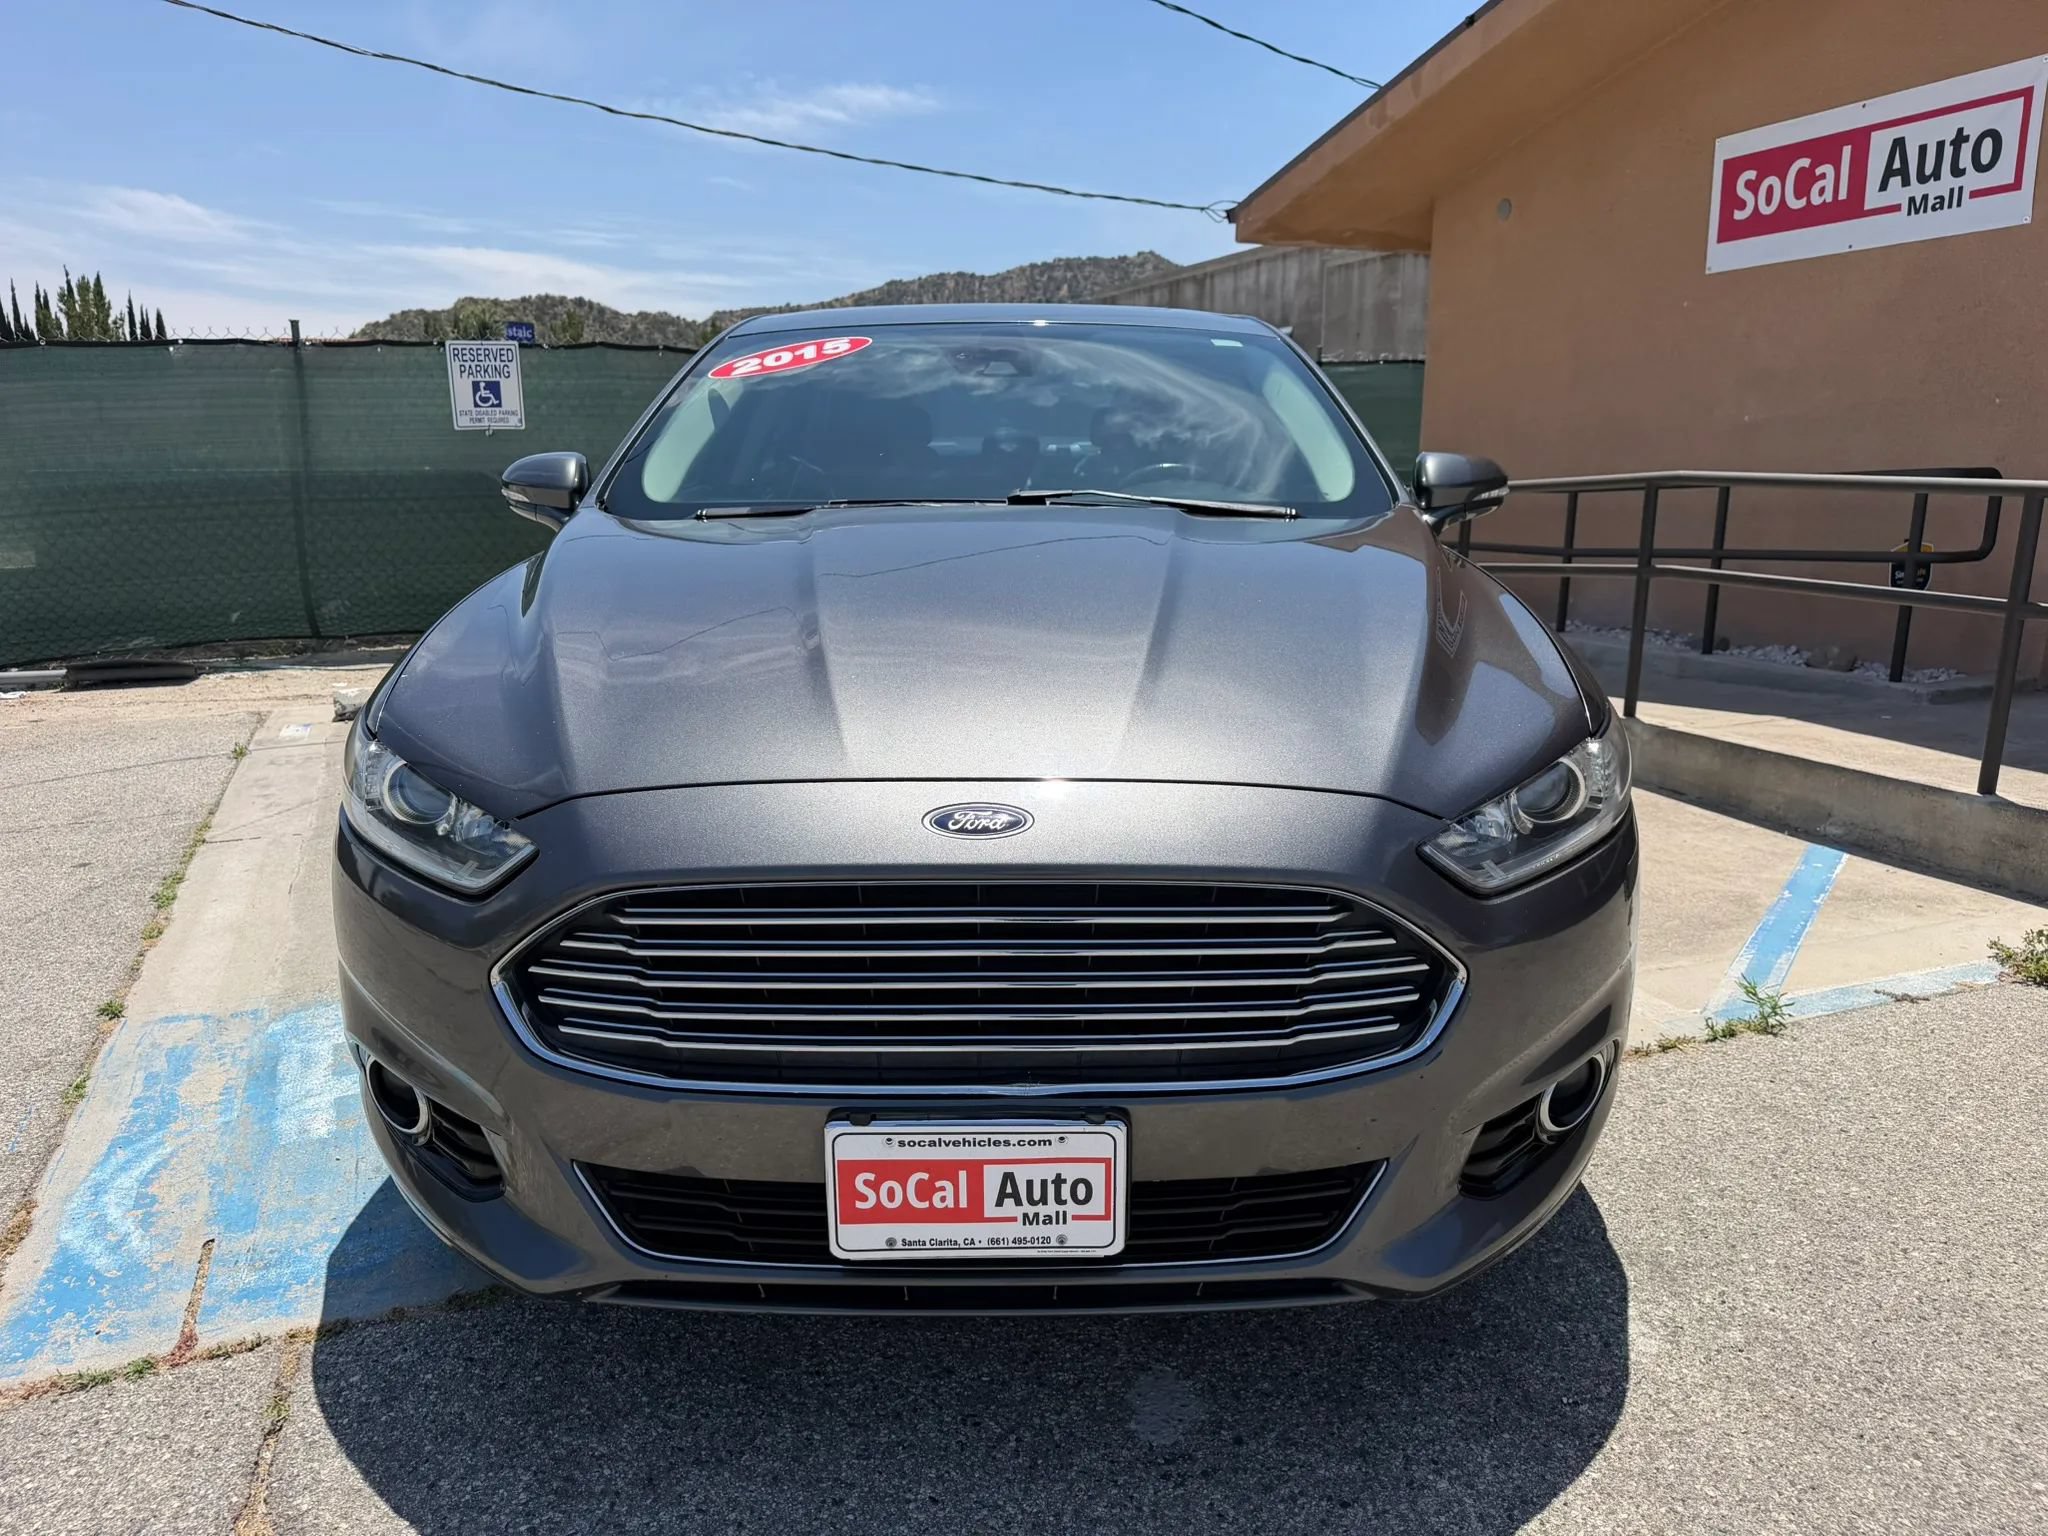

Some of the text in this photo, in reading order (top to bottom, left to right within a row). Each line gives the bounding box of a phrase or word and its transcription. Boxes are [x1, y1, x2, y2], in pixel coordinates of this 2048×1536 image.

[1732, 126, 2003, 221] SoCal Auto
[1906, 185, 1964, 217] Mall
[452, 347, 514, 362] RESERVED
[730, 338, 851, 376] 2015
[459, 364, 511, 379] PARKING
[948, 810, 1010, 830] Ford
[897, 1137, 1053, 1148] socalvehicles.com
[854, 1169, 1094, 1210] SoCal Auto
[1021, 1210, 1068, 1226] Mall
[901, 1235, 1051, 1248] Santa Clarita, CA (661) 495-0120
